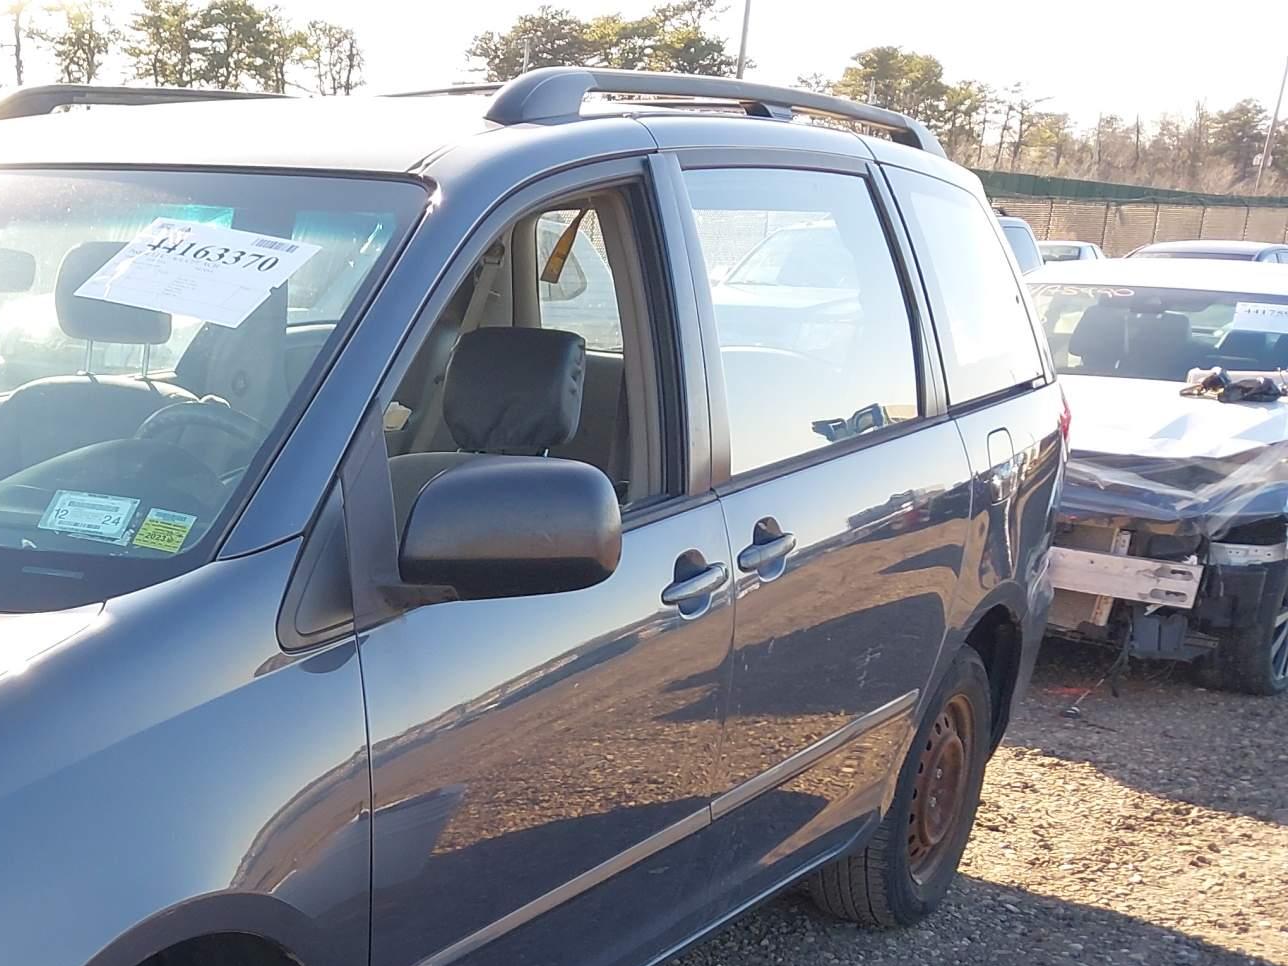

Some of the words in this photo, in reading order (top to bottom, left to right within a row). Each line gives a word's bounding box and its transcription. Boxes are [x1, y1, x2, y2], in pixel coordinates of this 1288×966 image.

[146, 236, 280, 272] 44163370
[54, 508, 69, 520] 12
[101, 515, 121, 526] 24
